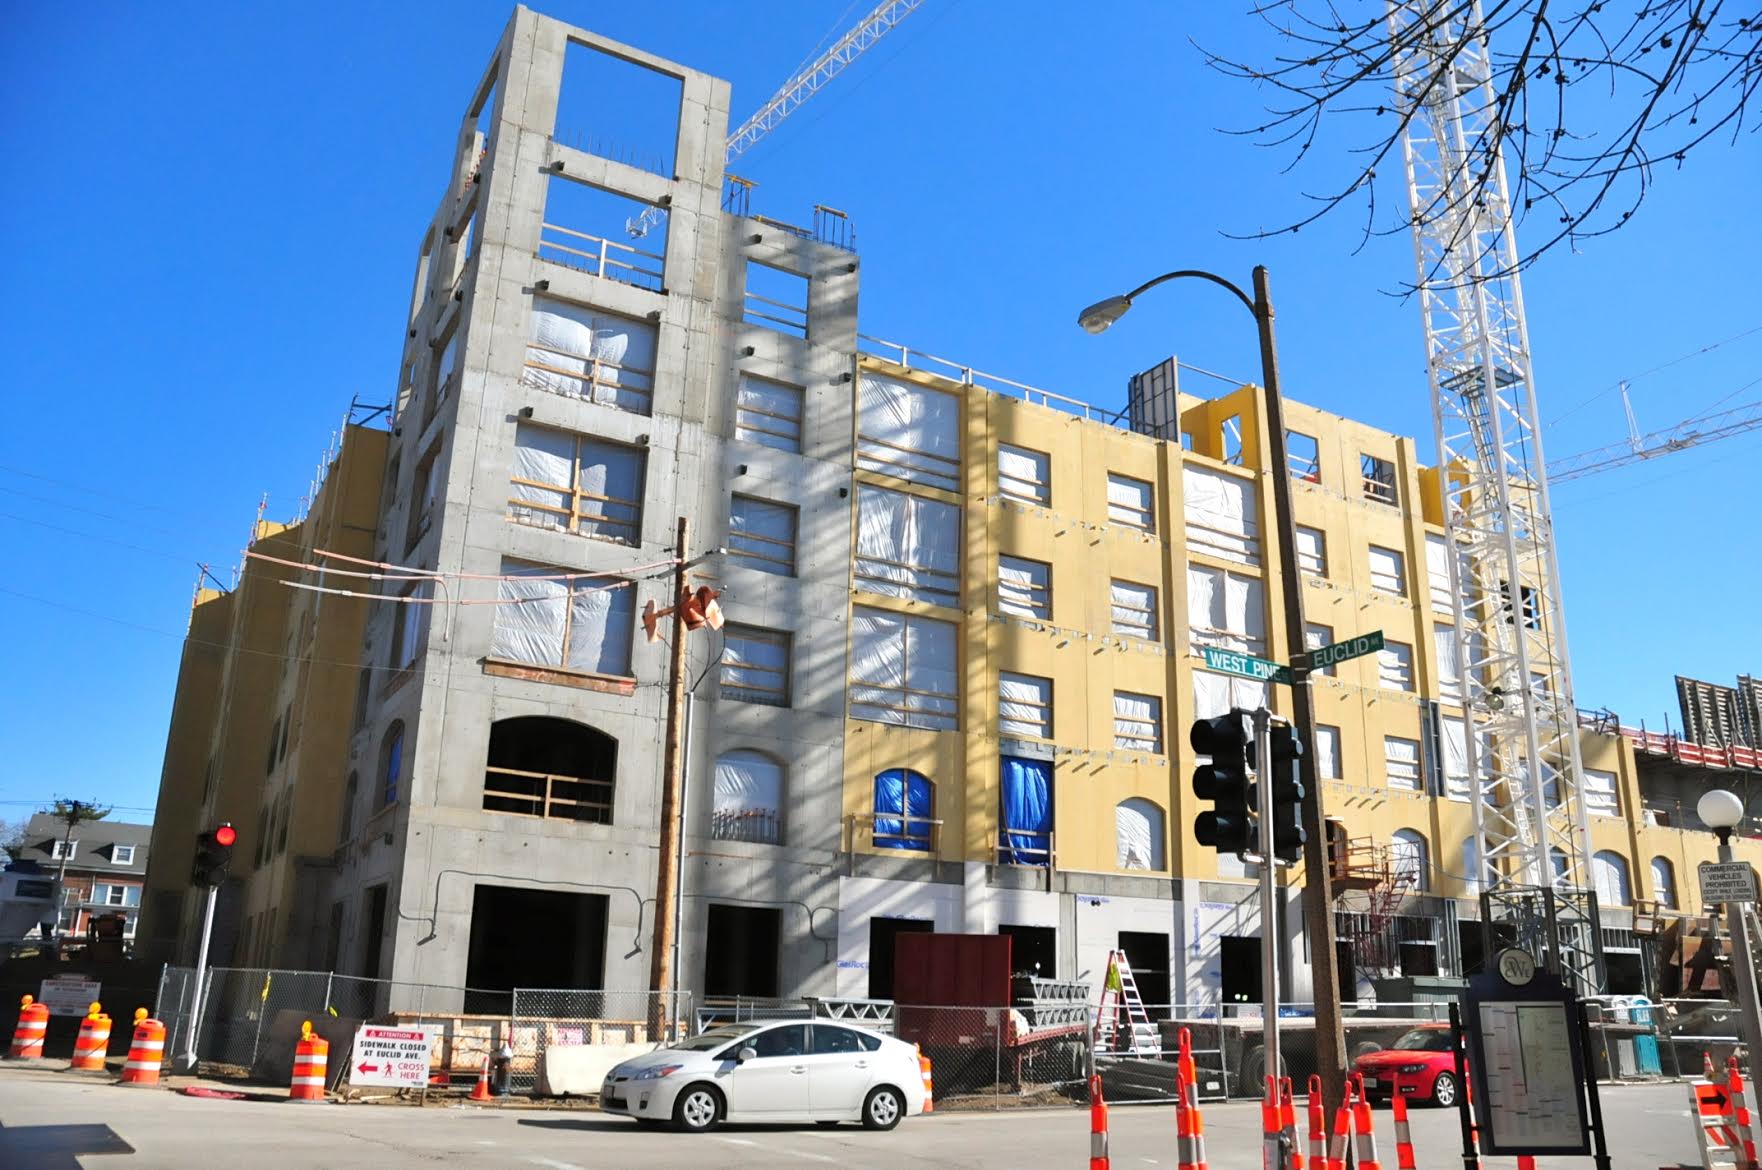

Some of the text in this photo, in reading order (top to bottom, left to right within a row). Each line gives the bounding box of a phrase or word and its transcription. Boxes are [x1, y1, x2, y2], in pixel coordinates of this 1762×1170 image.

[1313, 637, 1369, 668] EUCLID
[1209, 651, 1247, 673] WEST
[1252, 661, 1281, 681] PINE
[1701, 865, 1747, 873] COMMERCIAL
[1705, 880, 1746, 888] PROHIBITED
[378, 1031, 412, 1039] ATTENTION
[360, 1040, 427, 1052] SIDEWALK CLOSED
[377, 1050, 402, 1058] EUCLID
[404, 1052, 421, 1060] AVE.
[397, 1062, 425, 1071] CROSS
[400, 1071, 420, 1080] HERE
